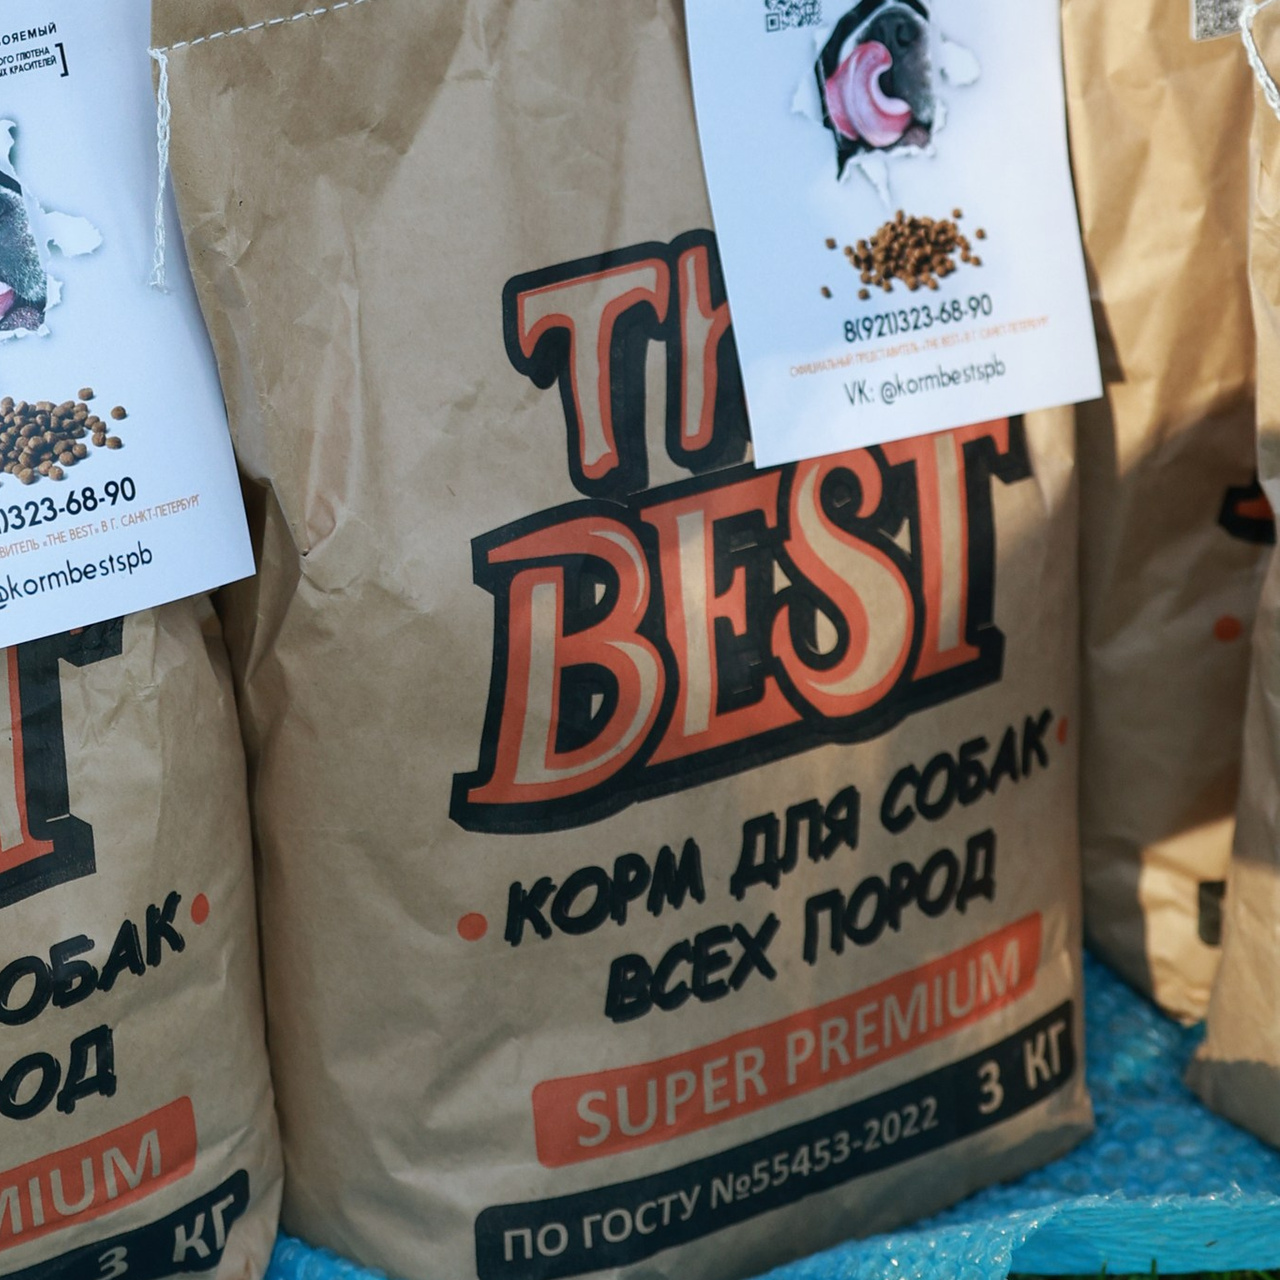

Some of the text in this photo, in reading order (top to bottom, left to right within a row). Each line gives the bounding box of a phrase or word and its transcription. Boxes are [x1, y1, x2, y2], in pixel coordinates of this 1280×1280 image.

[10, 56, 57, 74] КРАСИТЕЛЕЙ
[843, 294, 991, 343] 8(921)323-68-90
[880, 355, 1005, 405] @kormbestspb
[121, 494, 199, 526] САНКТ-ПЕТЕРБУРГ
[449, 414, 1035, 834] BEST
[504, 708, 1052, 946] КОРМ ДЛЯ СОБАК
[604, 828, 996, 1024] ВСЕХ ПОРОД
[576, 939, 1019, 1148] SUPER PREMIUM
[504, 1021, 1066, 1261] ПО ГОСТУ №55453-2022 3 КГ
[172, 1191, 237, 1264] КГ
